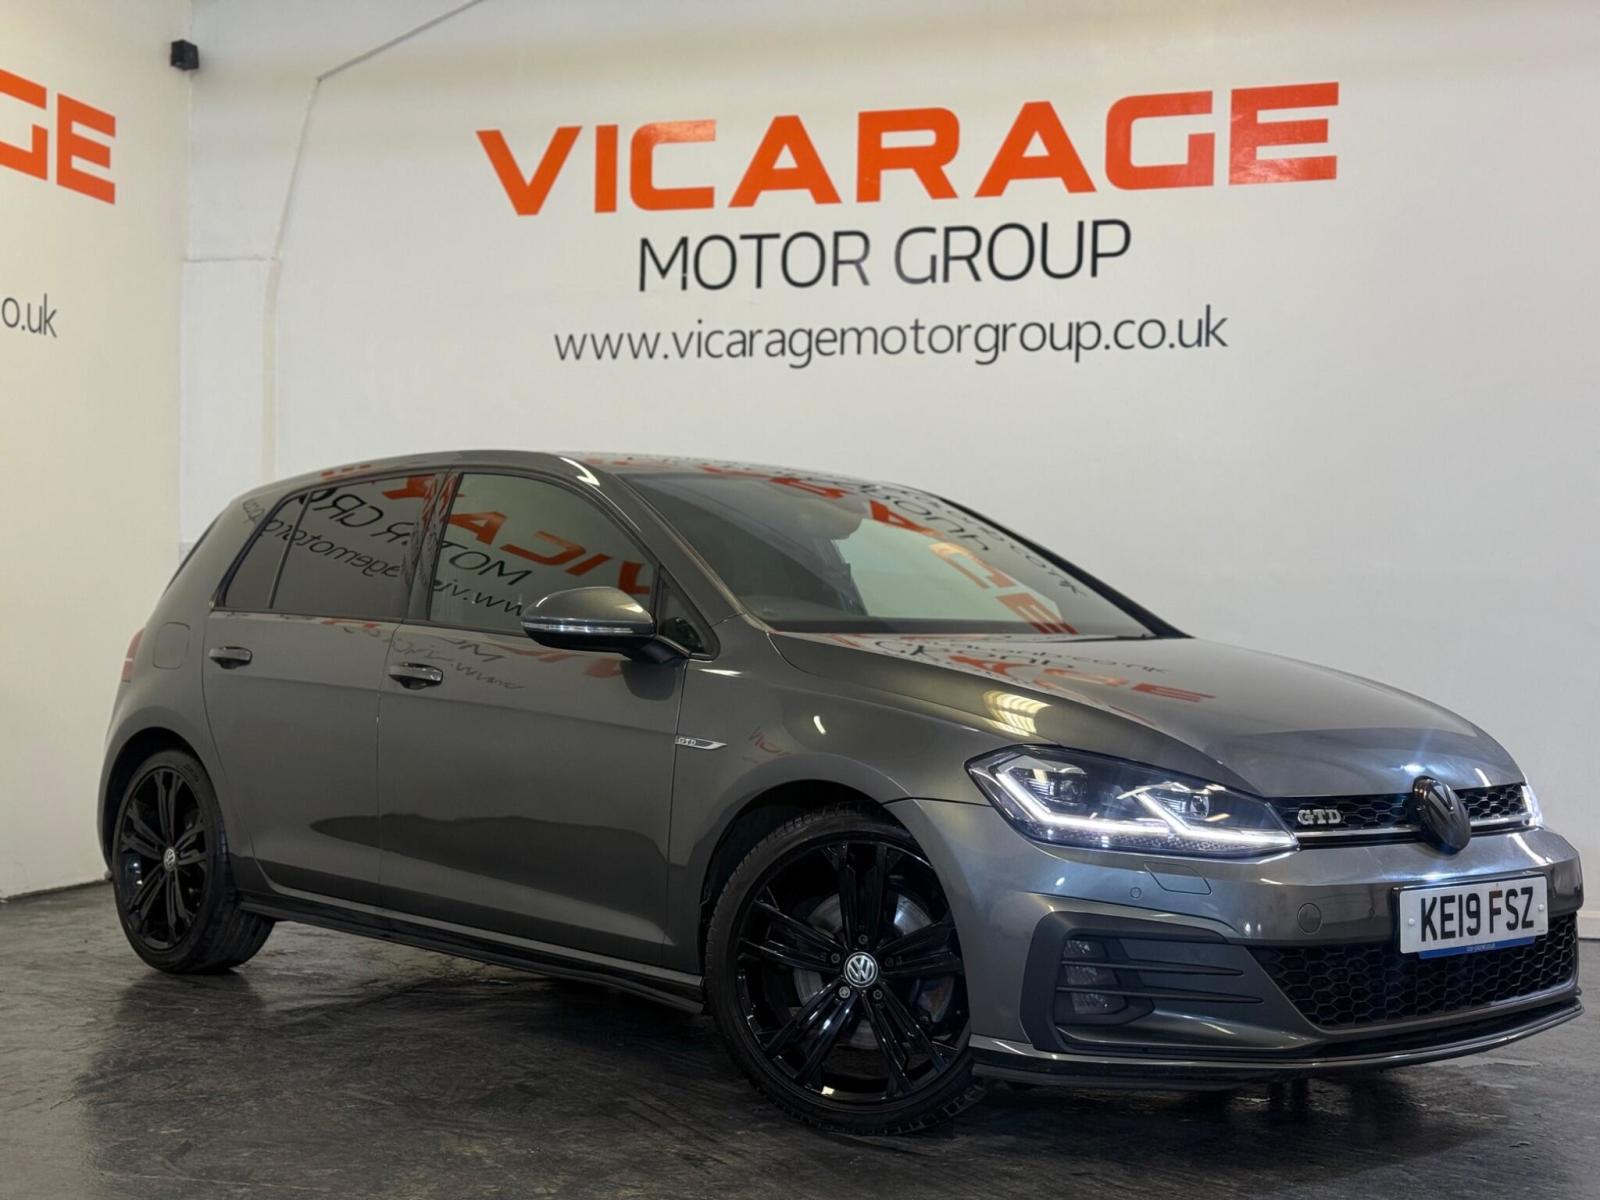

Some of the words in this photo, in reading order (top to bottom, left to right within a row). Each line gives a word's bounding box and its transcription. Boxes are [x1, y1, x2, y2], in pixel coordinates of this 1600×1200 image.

[476, 82, 1339, 216] VICARAGE
[638, 230, 870, 292] MOTOR
[894, 218, 1132, 285] GROUP
[2, 292, 58, 338] o.uk
[554, 304, 1229, 370] www.vicaragemotorgroup.co.uk
[1297, 809, 1342, 825] GTD
[1421, 892, 1482, 942] KE19
[1488, 886, 1535, 934] FSZ
